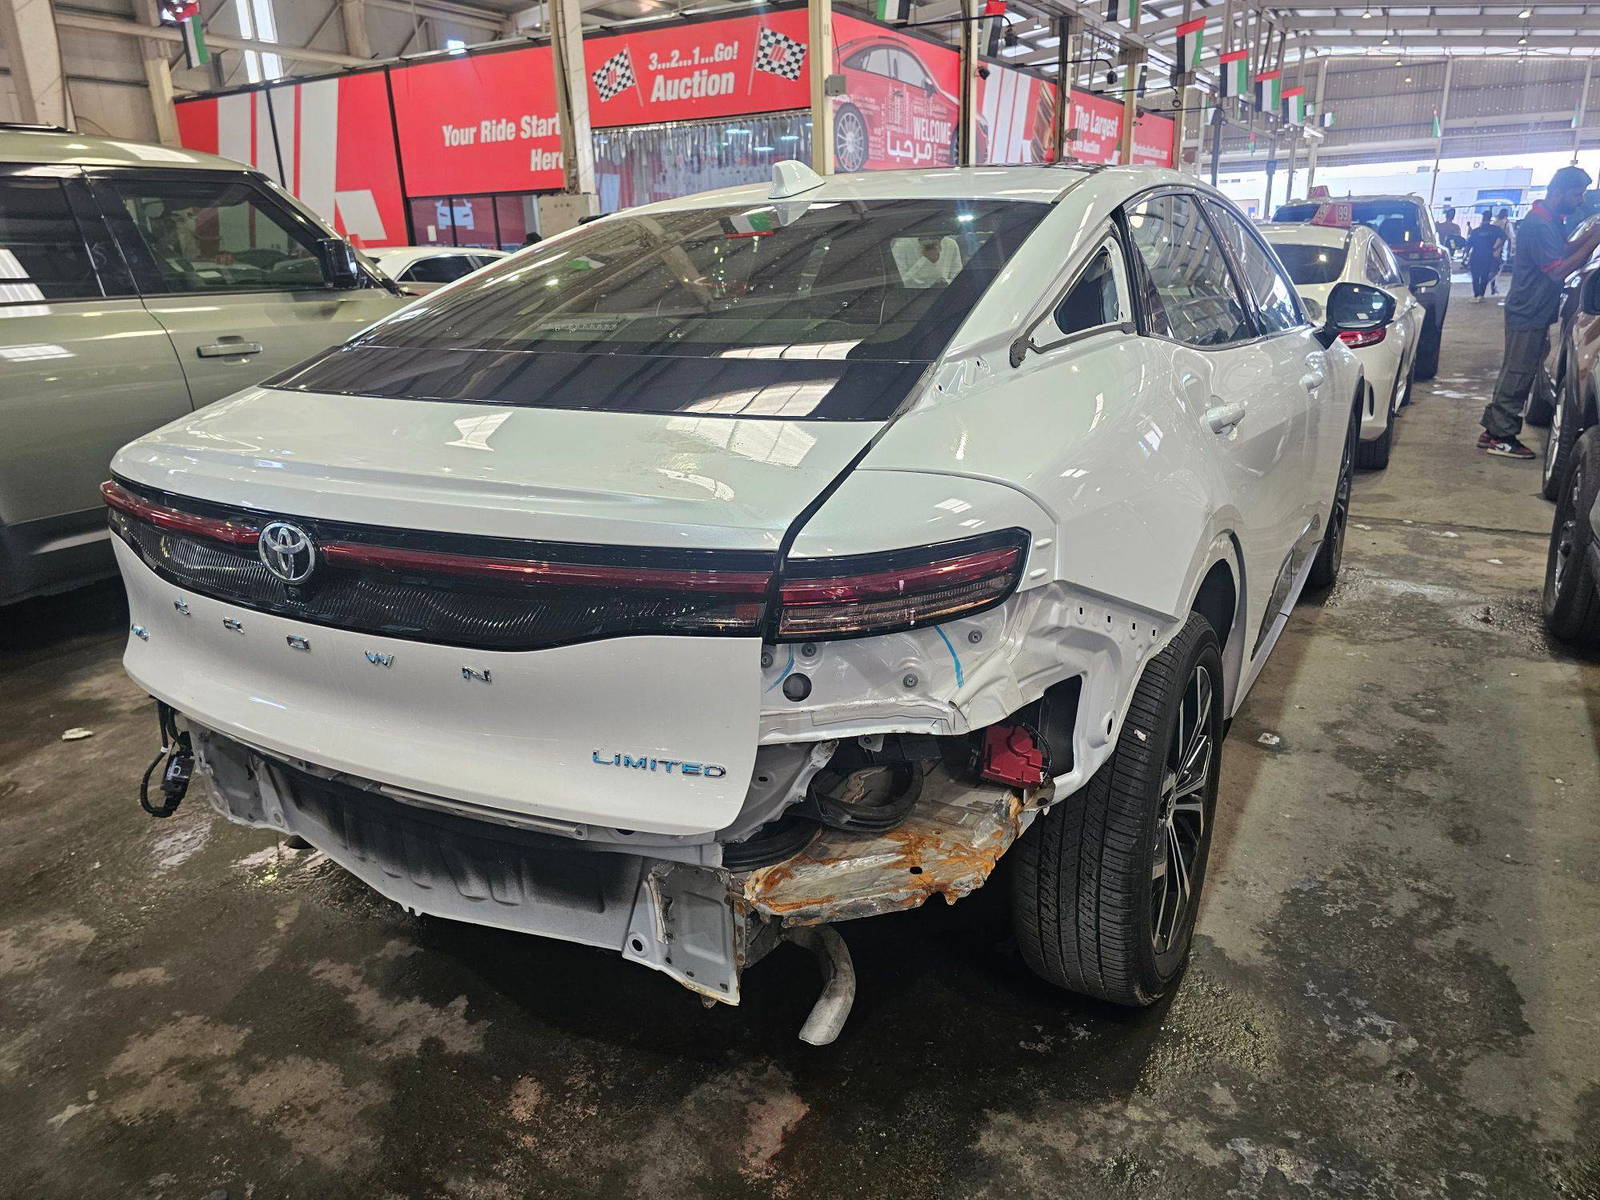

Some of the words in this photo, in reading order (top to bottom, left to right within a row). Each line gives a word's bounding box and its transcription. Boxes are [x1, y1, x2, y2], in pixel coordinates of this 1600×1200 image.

[650, 69, 736, 102] Auction
[442, 124, 478, 147] Your
[480, 118, 516, 144] Ride
[913, 116, 952, 145] WELCOME
[1075, 104, 1090, 132] The
[1090, 109, 1119, 141] Largest
[886, 127, 932, 165] مرحبا
[592, 750, 727, 778] LIMITED
